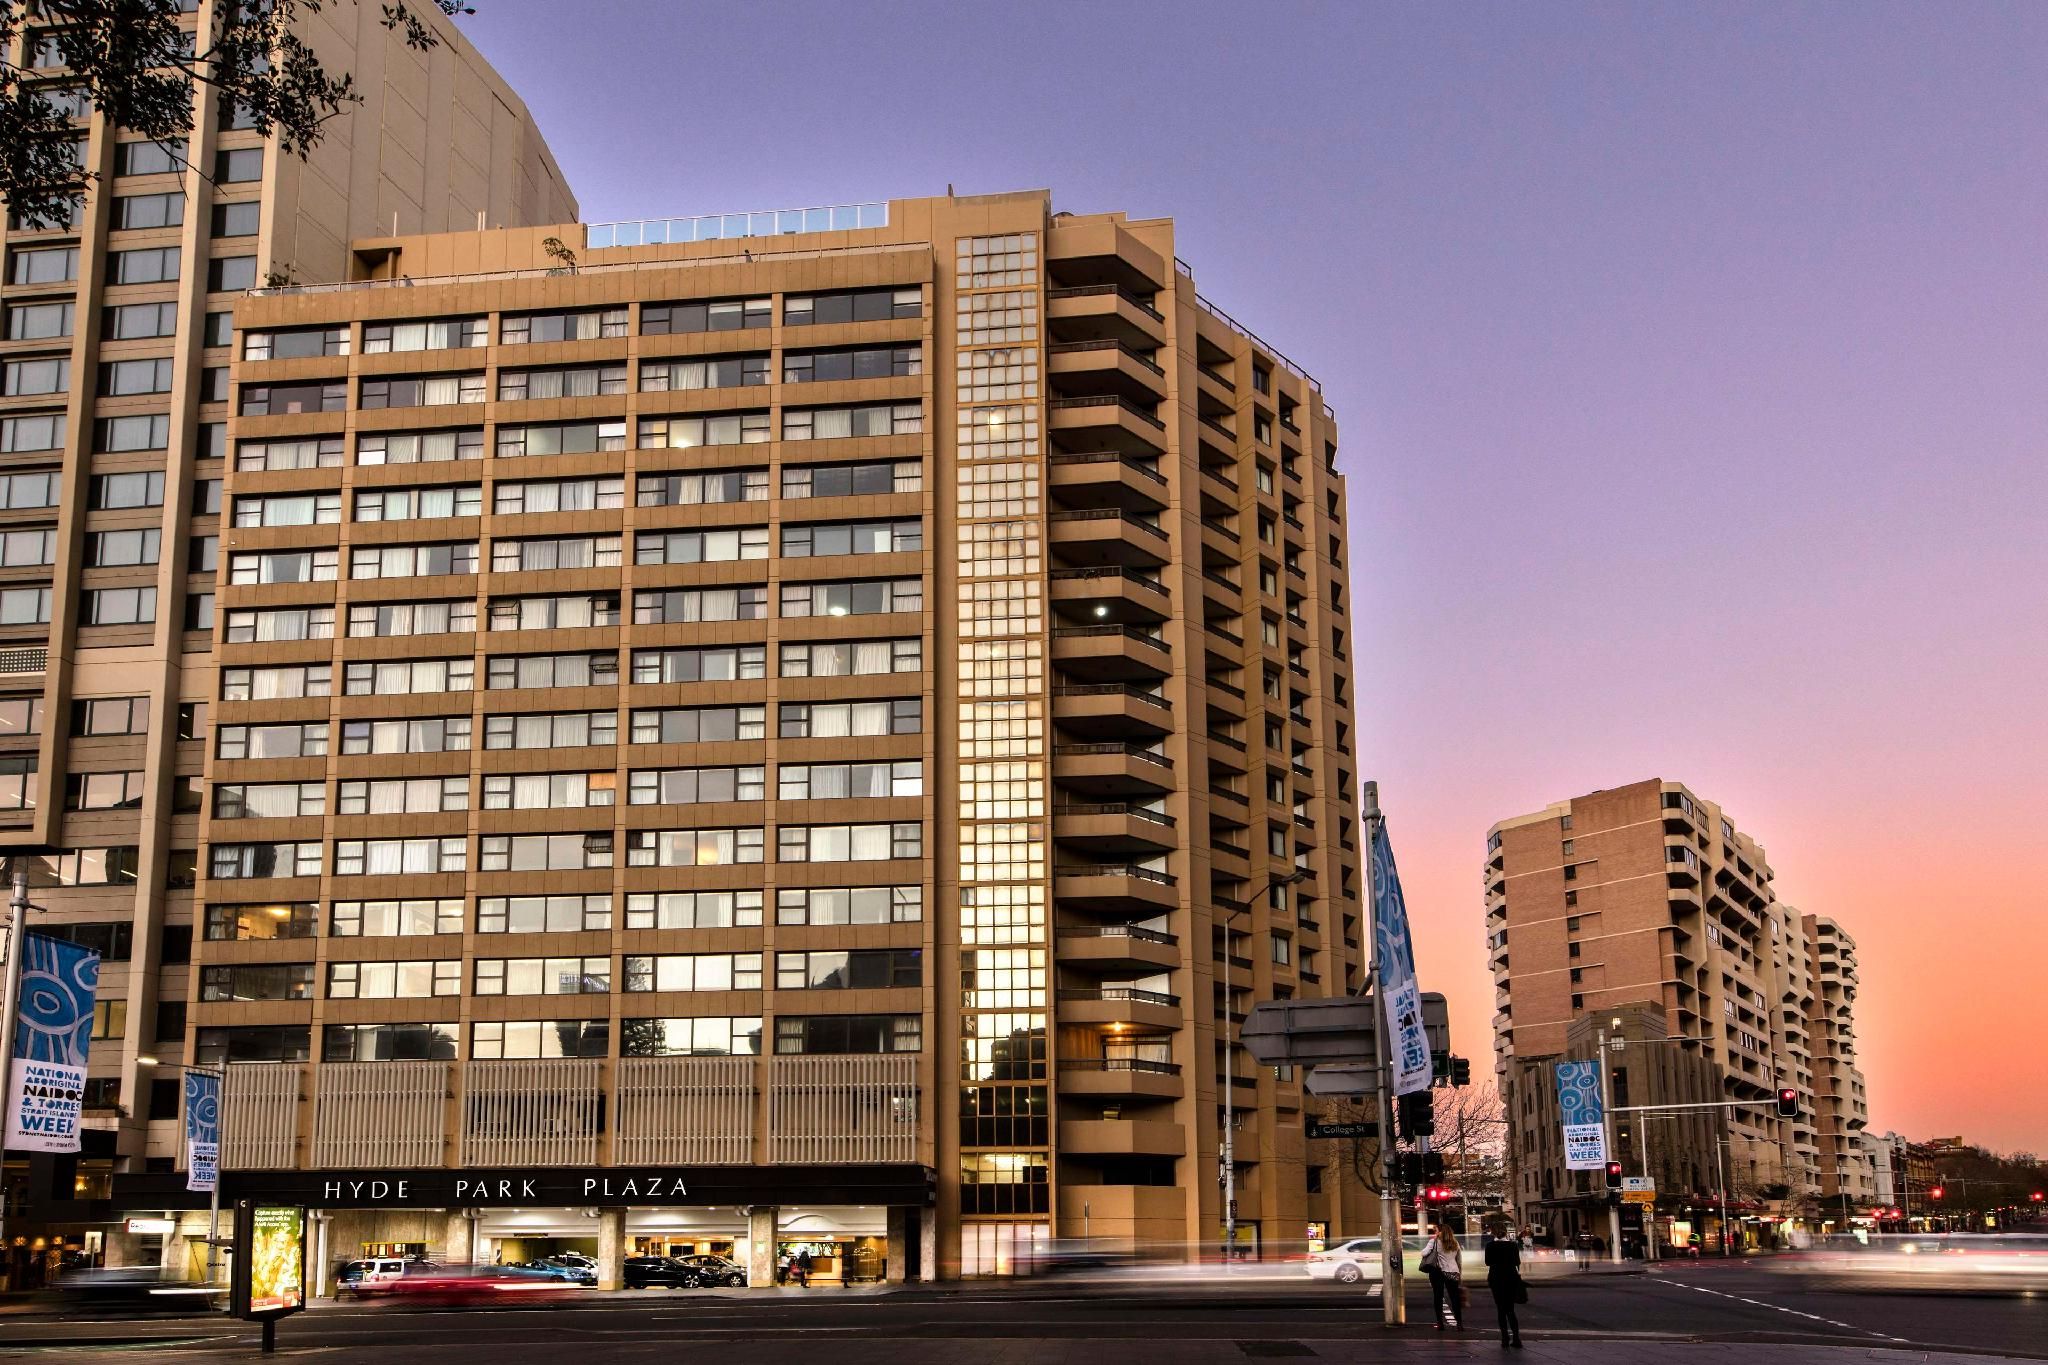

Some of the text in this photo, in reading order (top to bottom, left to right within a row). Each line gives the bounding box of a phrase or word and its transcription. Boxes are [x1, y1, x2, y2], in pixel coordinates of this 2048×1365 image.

[26, 1066, 82, 1081] NATIONA
[23, 1085, 82, 1101] NAIDOC
[38, 1098, 80, 1112] TORRES
[1323, 1125, 1365, 1135] College St
[1569, 1150, 1602, 1159] WEEK
[324, 1178, 687, 1199] HYDE PARK PLAZA
